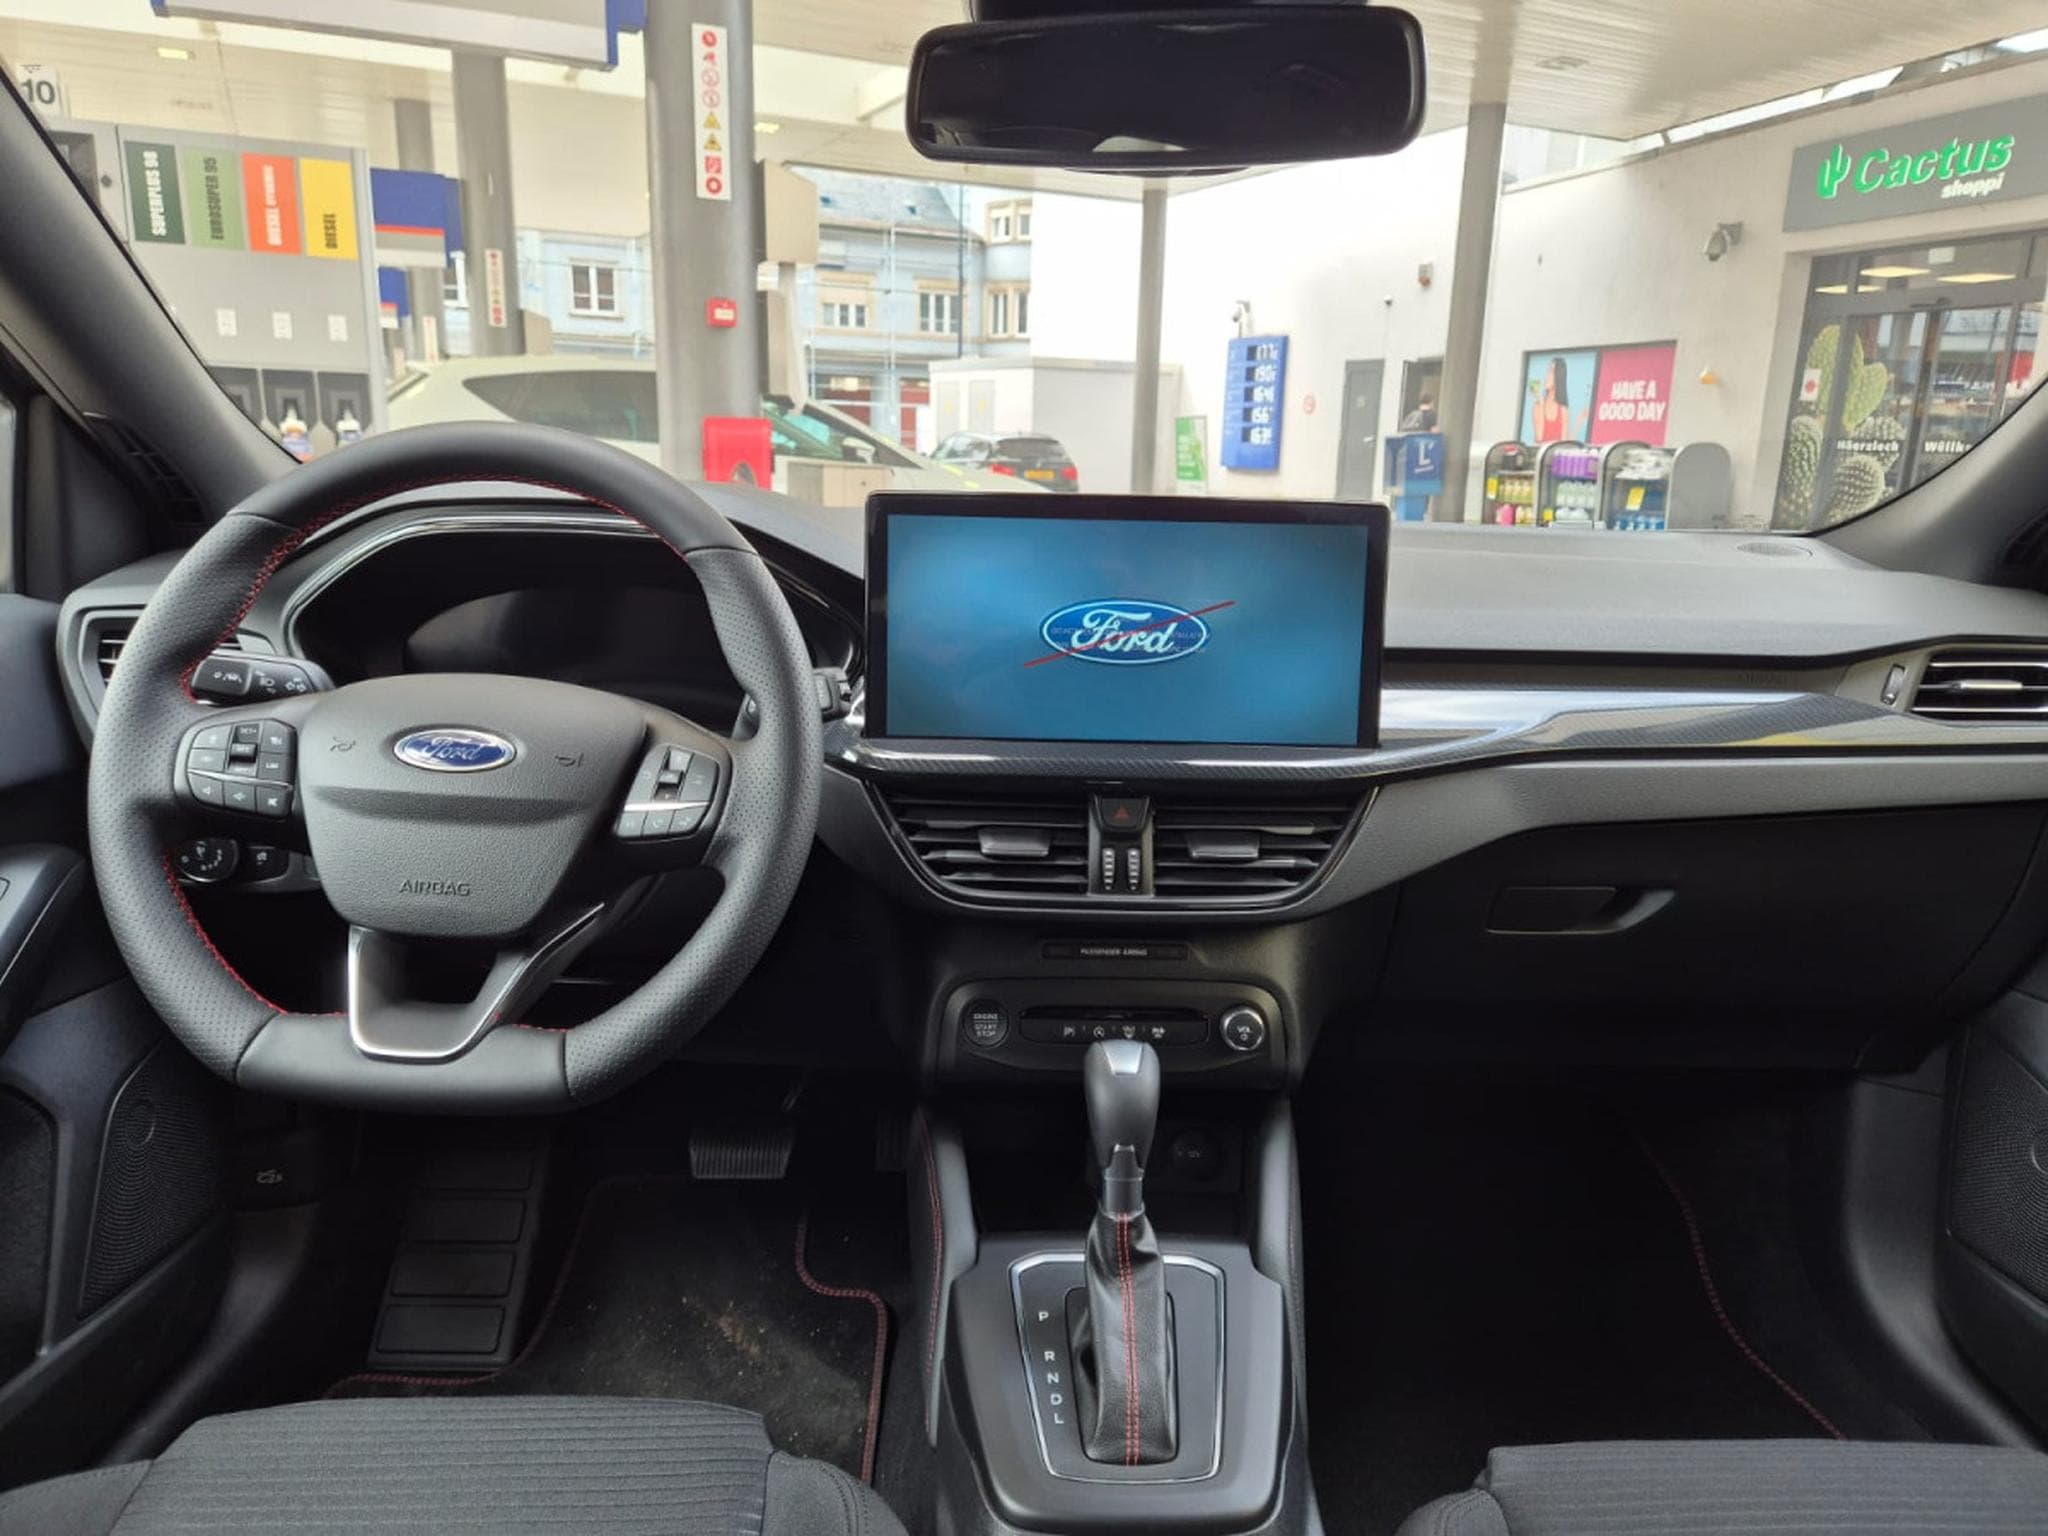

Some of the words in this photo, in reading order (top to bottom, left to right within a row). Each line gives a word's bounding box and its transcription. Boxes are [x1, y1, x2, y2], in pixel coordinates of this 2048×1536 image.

[20, 79, 56, 105] 10
[1853, 134, 2016, 195] Cactus
[1940, 171, 2006, 199] shoppi
[145, 170, 167, 237] SUPERPLUS
[205, 174, 224, 240] EUROSUPER
[1611, 380, 1646, 400] HAVE
[1645, 380, 1657, 400] A
[1599, 401, 1635, 421] GOOD
[1636, 401, 1666, 421] DAY
[1071, 608, 1178, 653] Ford
[421, 736, 483, 761] Ford
[400, 880, 471, 897] AIRBAG
[1038, 1311, 1050, 1322] P
[1043, 1350, 1056, 1362] R
[1047, 1372, 1060, 1385] N
[1050, 1393, 1063, 1406] D
[1054, 1413, 1065, 1425] L
